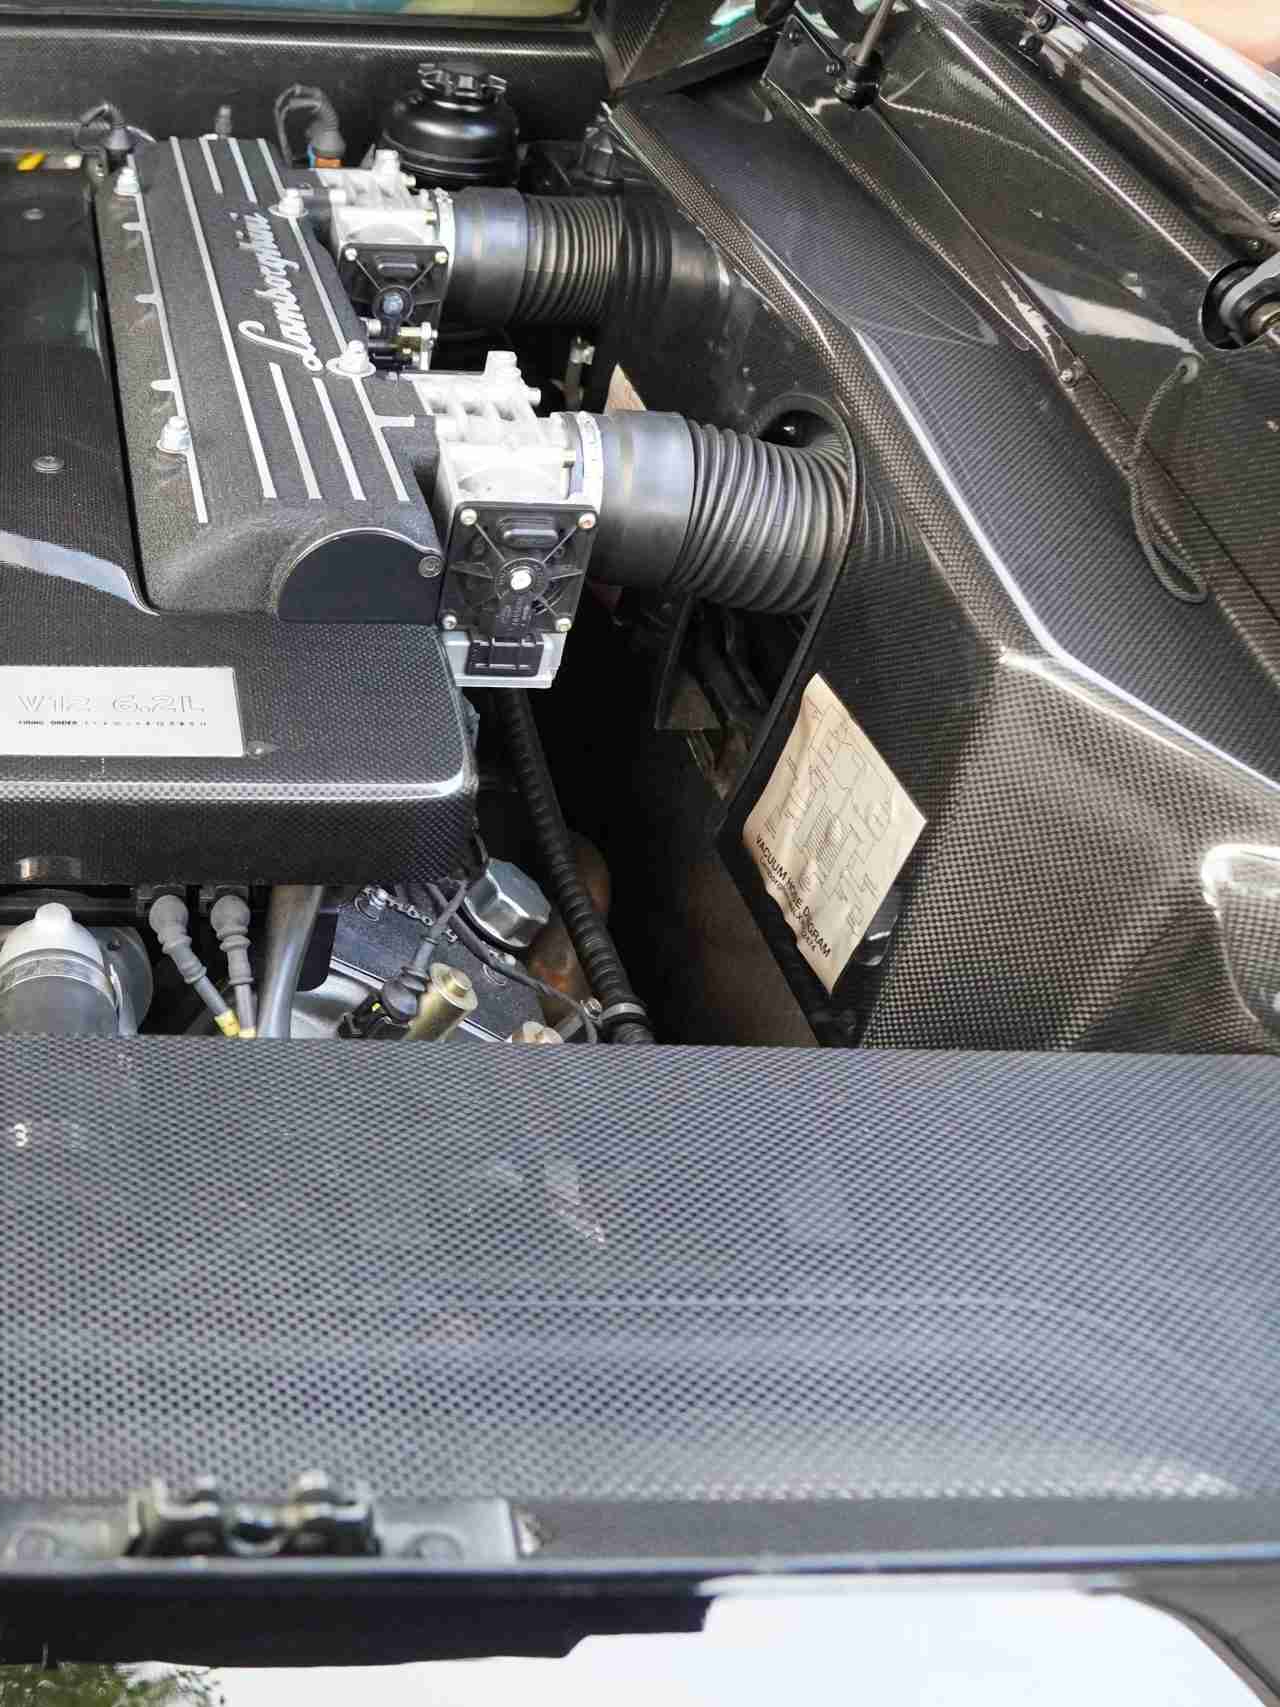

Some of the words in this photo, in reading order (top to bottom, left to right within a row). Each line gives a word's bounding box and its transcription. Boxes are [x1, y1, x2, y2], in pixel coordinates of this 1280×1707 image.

[229, 212, 323, 371] Lamborghini
[17, 695, 91, 712] V12
[112, 695, 206, 712] 6.2L
[756, 835, 787, 881] VACUUM
[803, 905, 831, 957] DGRAM
